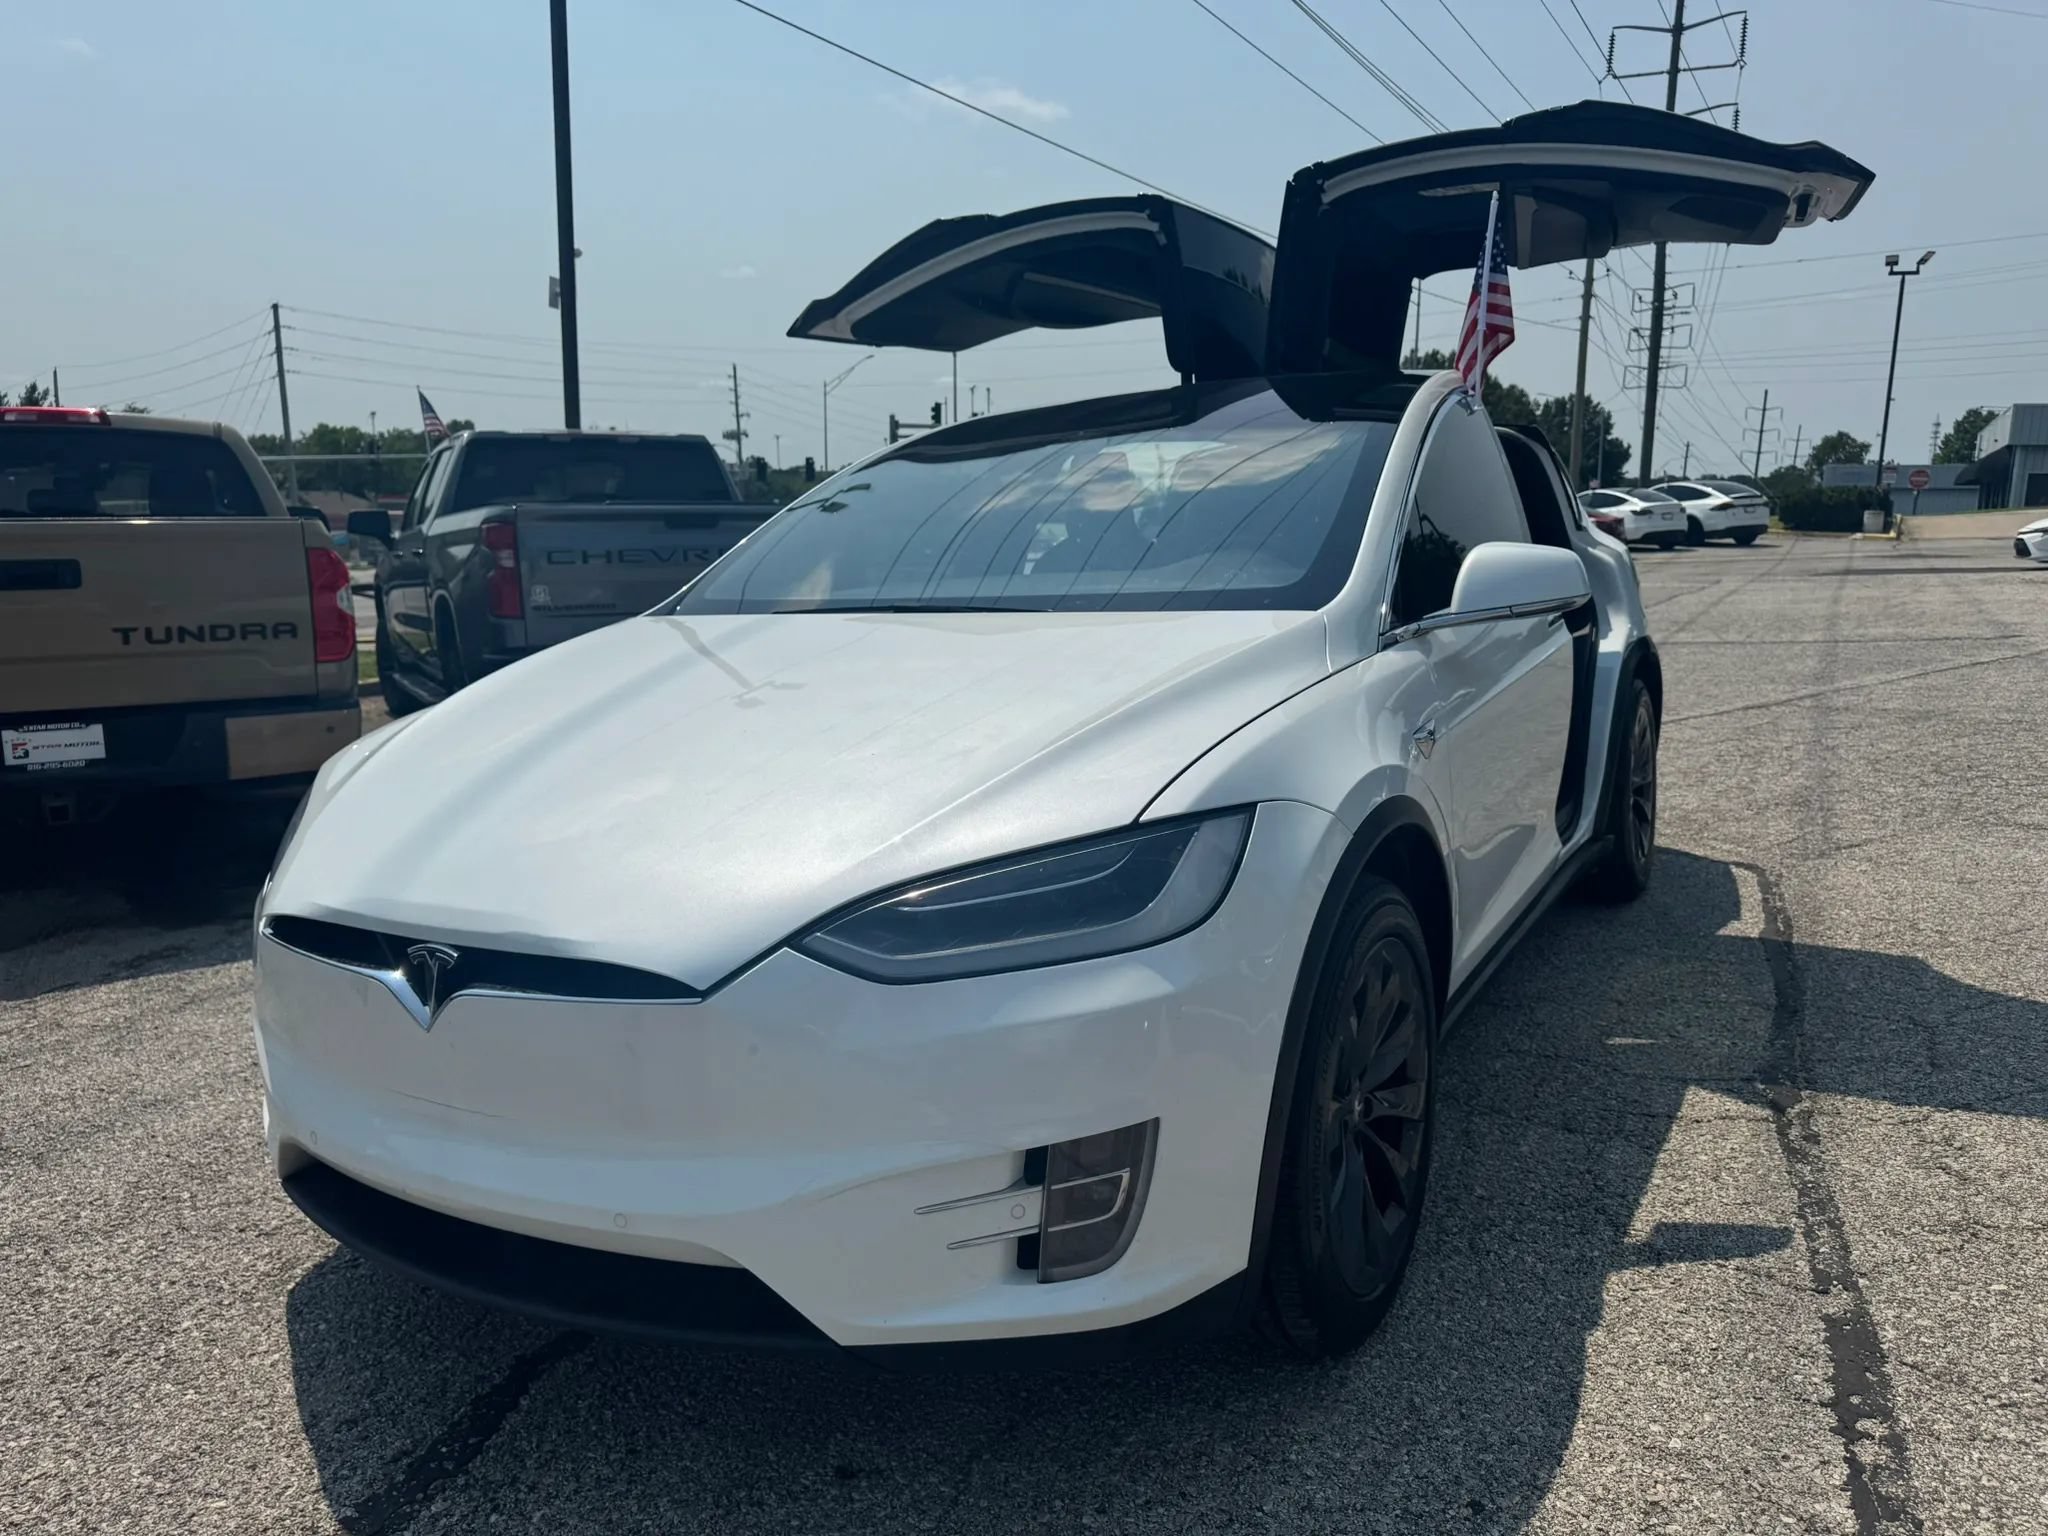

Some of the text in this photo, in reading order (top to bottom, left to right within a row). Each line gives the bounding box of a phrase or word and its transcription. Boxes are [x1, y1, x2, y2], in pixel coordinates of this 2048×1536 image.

[546, 548, 724, 565] CHEVR
[111, 622, 298, 646] TUNDRA
[47, 722, 70, 730] MOTOR
